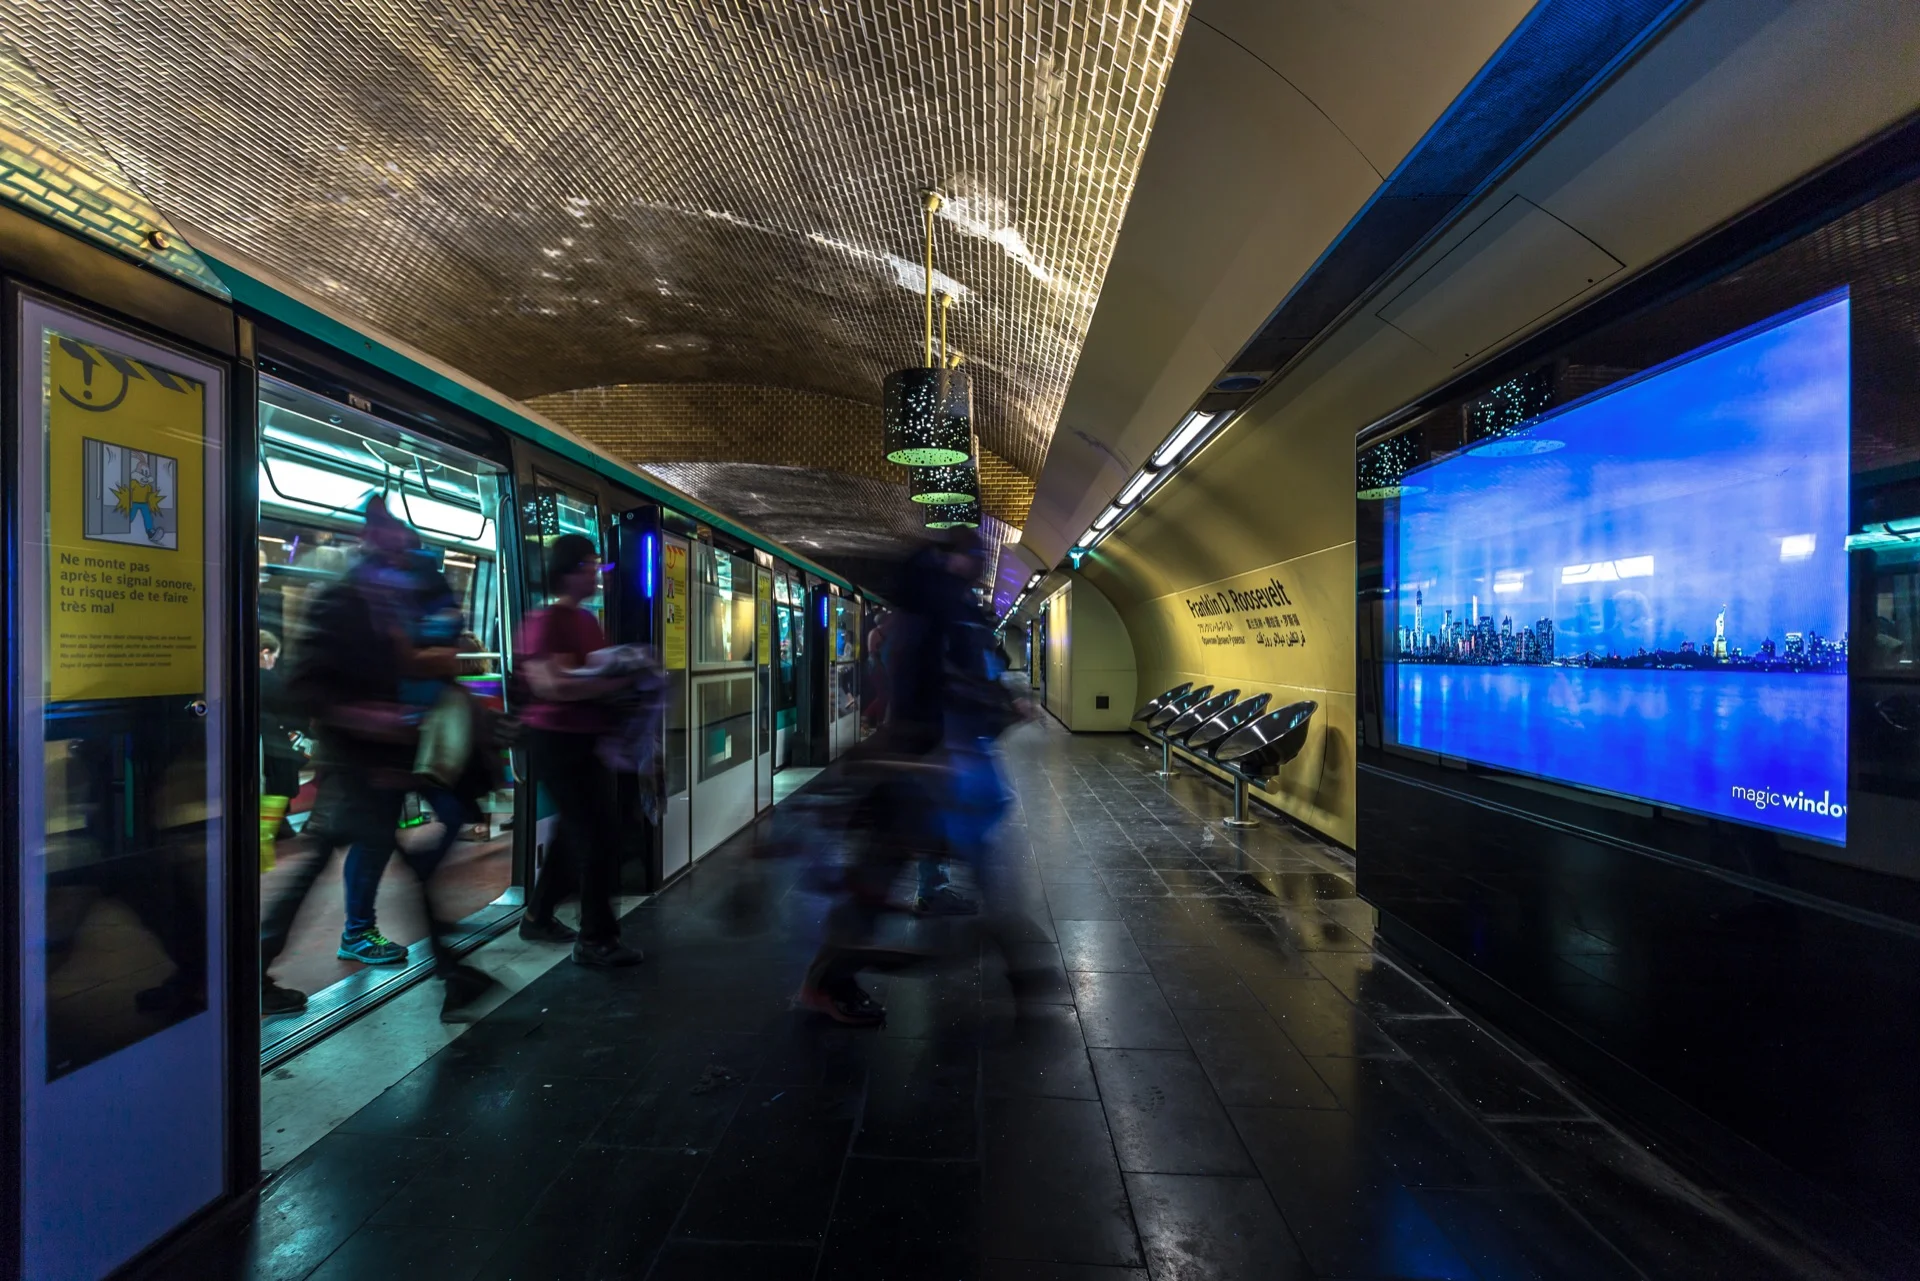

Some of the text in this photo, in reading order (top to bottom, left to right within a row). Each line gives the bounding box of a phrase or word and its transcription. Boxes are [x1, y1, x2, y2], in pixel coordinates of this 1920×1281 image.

[60, 552, 150, 573] Ne monte pas
[60, 570, 196, 592] après le signal sonore,
[60, 585, 189, 603] tu risques de te faire
[1186, 578, 1292, 618] Franklin D. Roosevelt
[60, 601, 115, 614] très mal
[1732, 786, 1847, 818] magic windo
